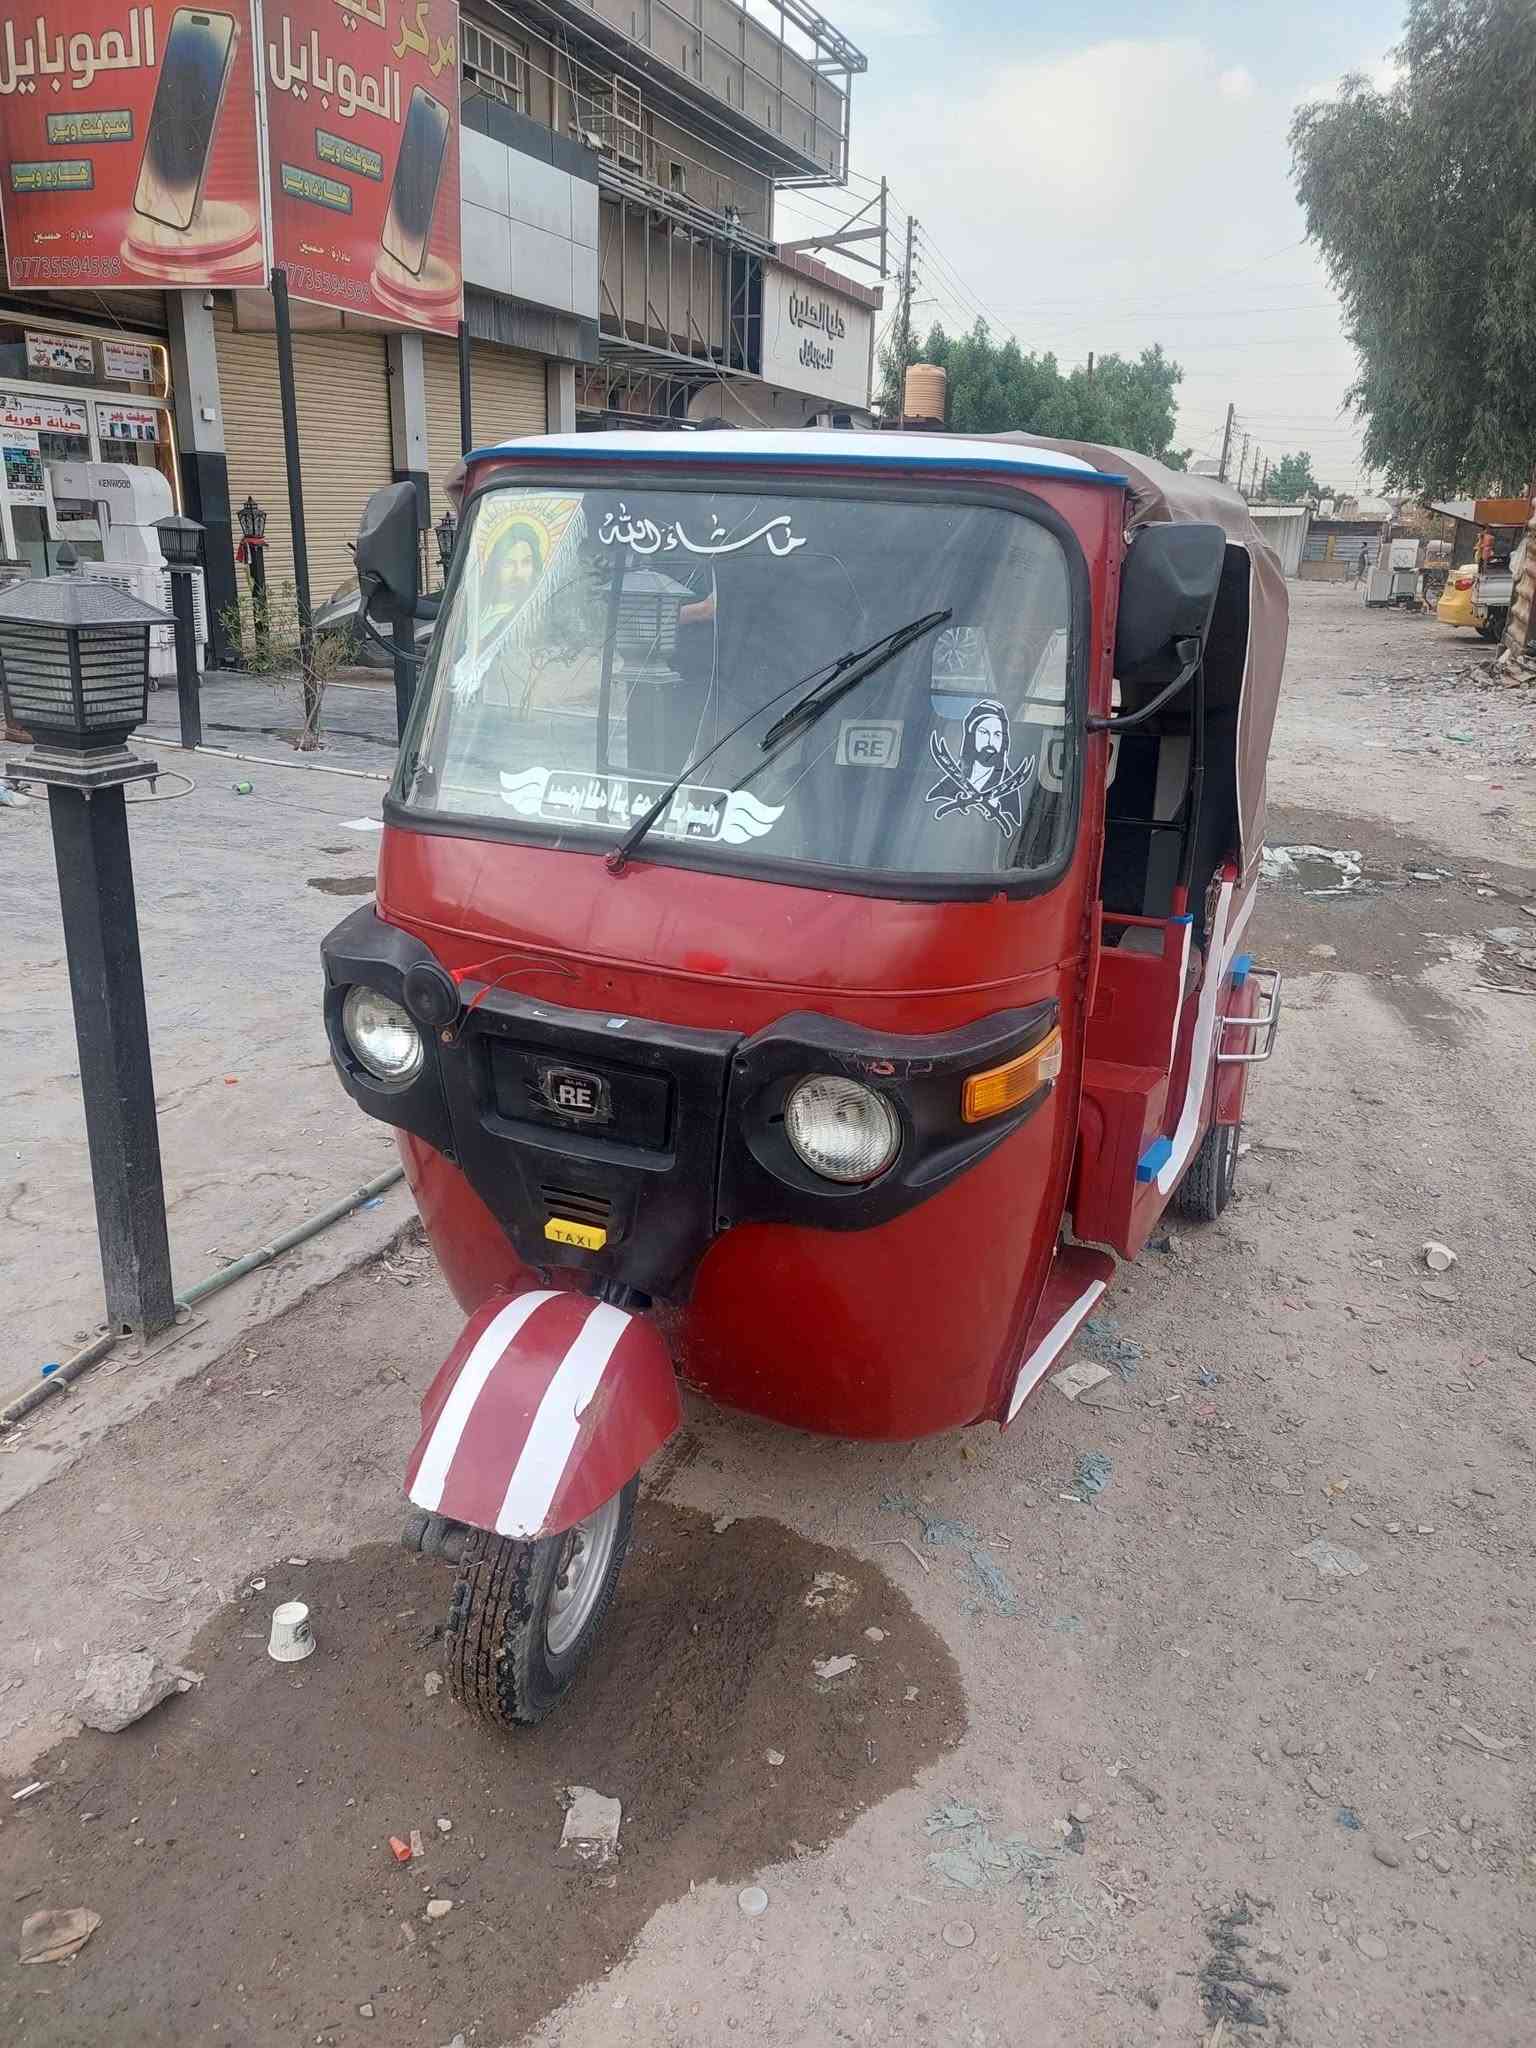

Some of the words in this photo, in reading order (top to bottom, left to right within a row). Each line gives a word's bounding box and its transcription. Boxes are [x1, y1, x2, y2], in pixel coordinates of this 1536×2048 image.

[0, 6, 156, 95] الموبايل
[269, 15, 400, 124] الموبايل
[80, 117, 130, 139] سوفت
[33, 231, 62, 244] حسين
[5, 411, 41, 427] فورية
[47, 414, 81, 432] صيانة
[854, 740, 884, 757] RE
[560, 1084, 592, 1108] RE
[555, 1230, 592, 1247] TAXI
